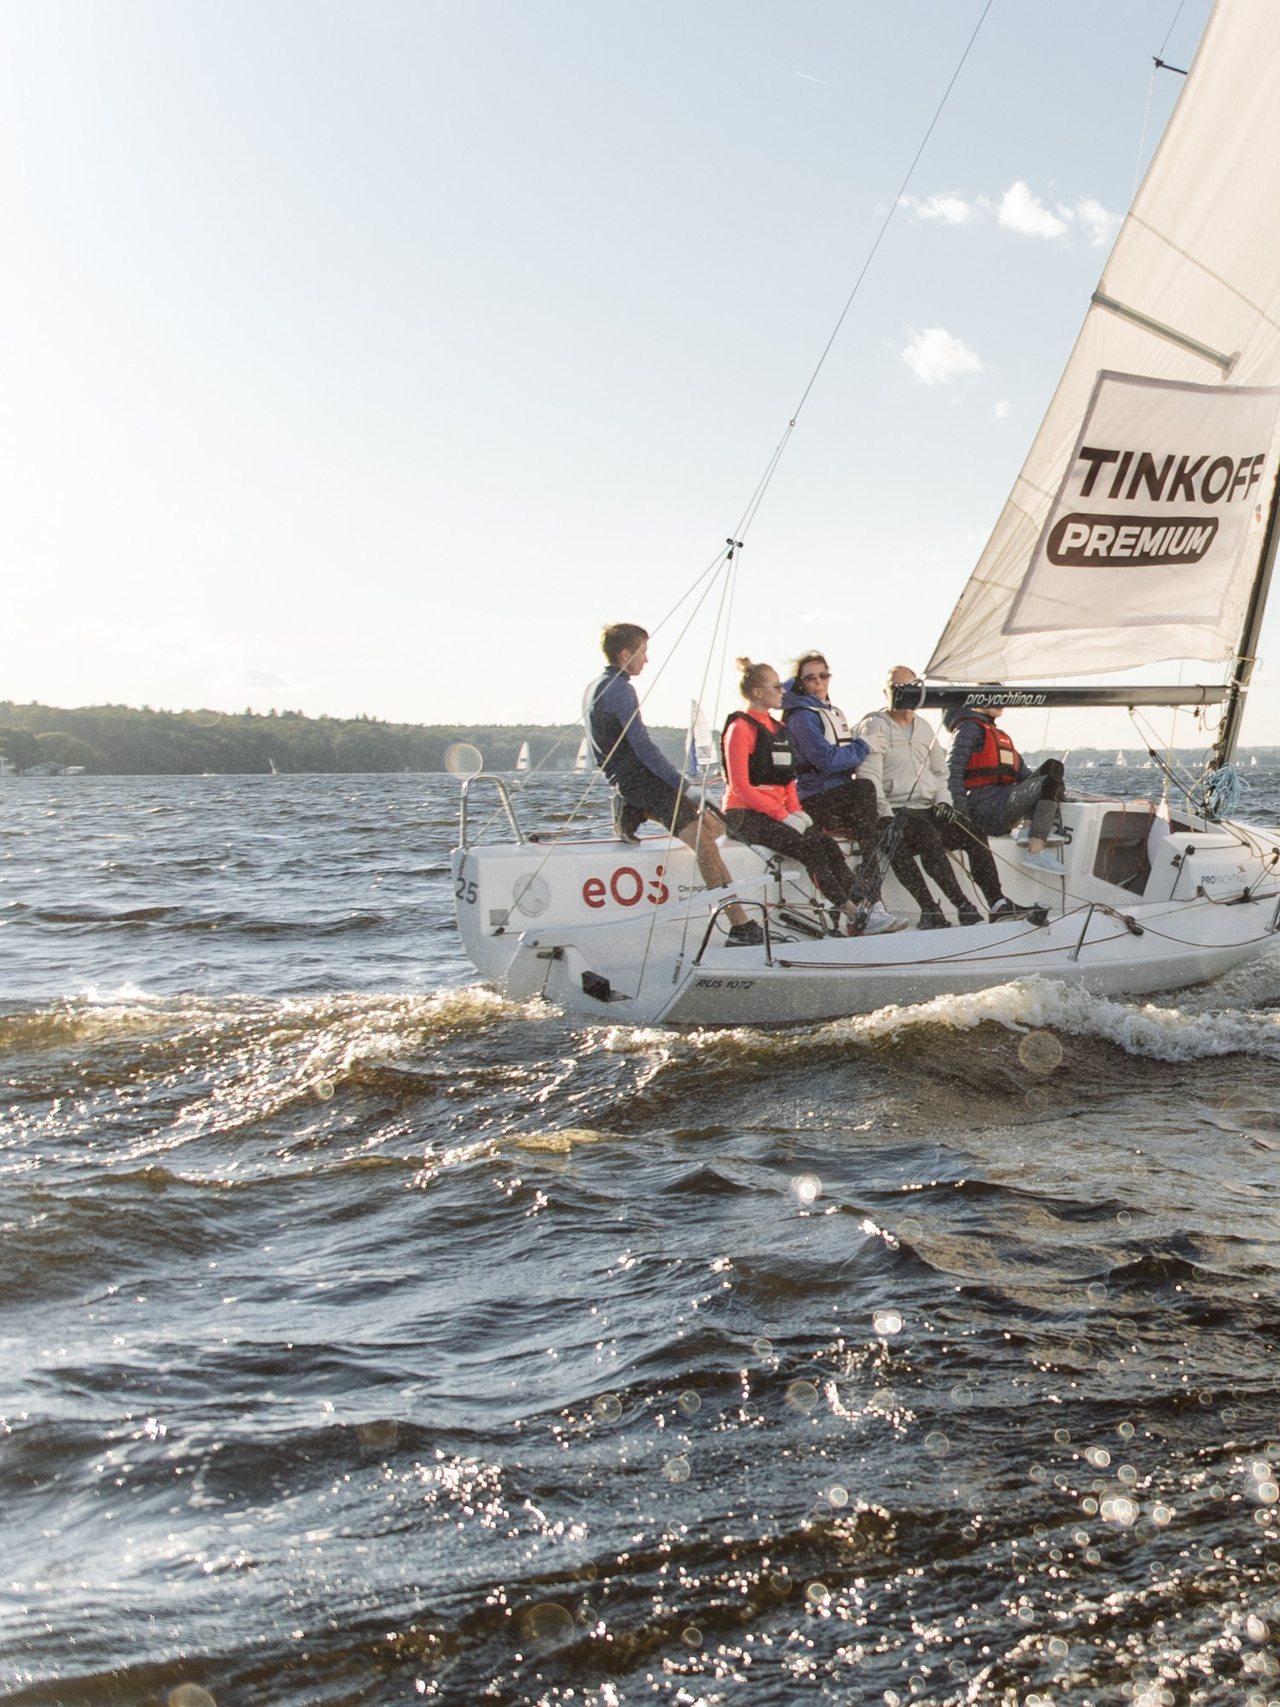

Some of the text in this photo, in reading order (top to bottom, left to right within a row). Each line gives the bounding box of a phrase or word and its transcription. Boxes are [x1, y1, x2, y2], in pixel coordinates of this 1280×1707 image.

[1078, 446, 1265, 504] TINKOFF
[1057, 522, 1213, 557] PREMIUM
[963, 691, 1046, 707] pro-yachting.ru
[454, 877, 479, 904] 25
[695, 979, 723, 988] RUS
